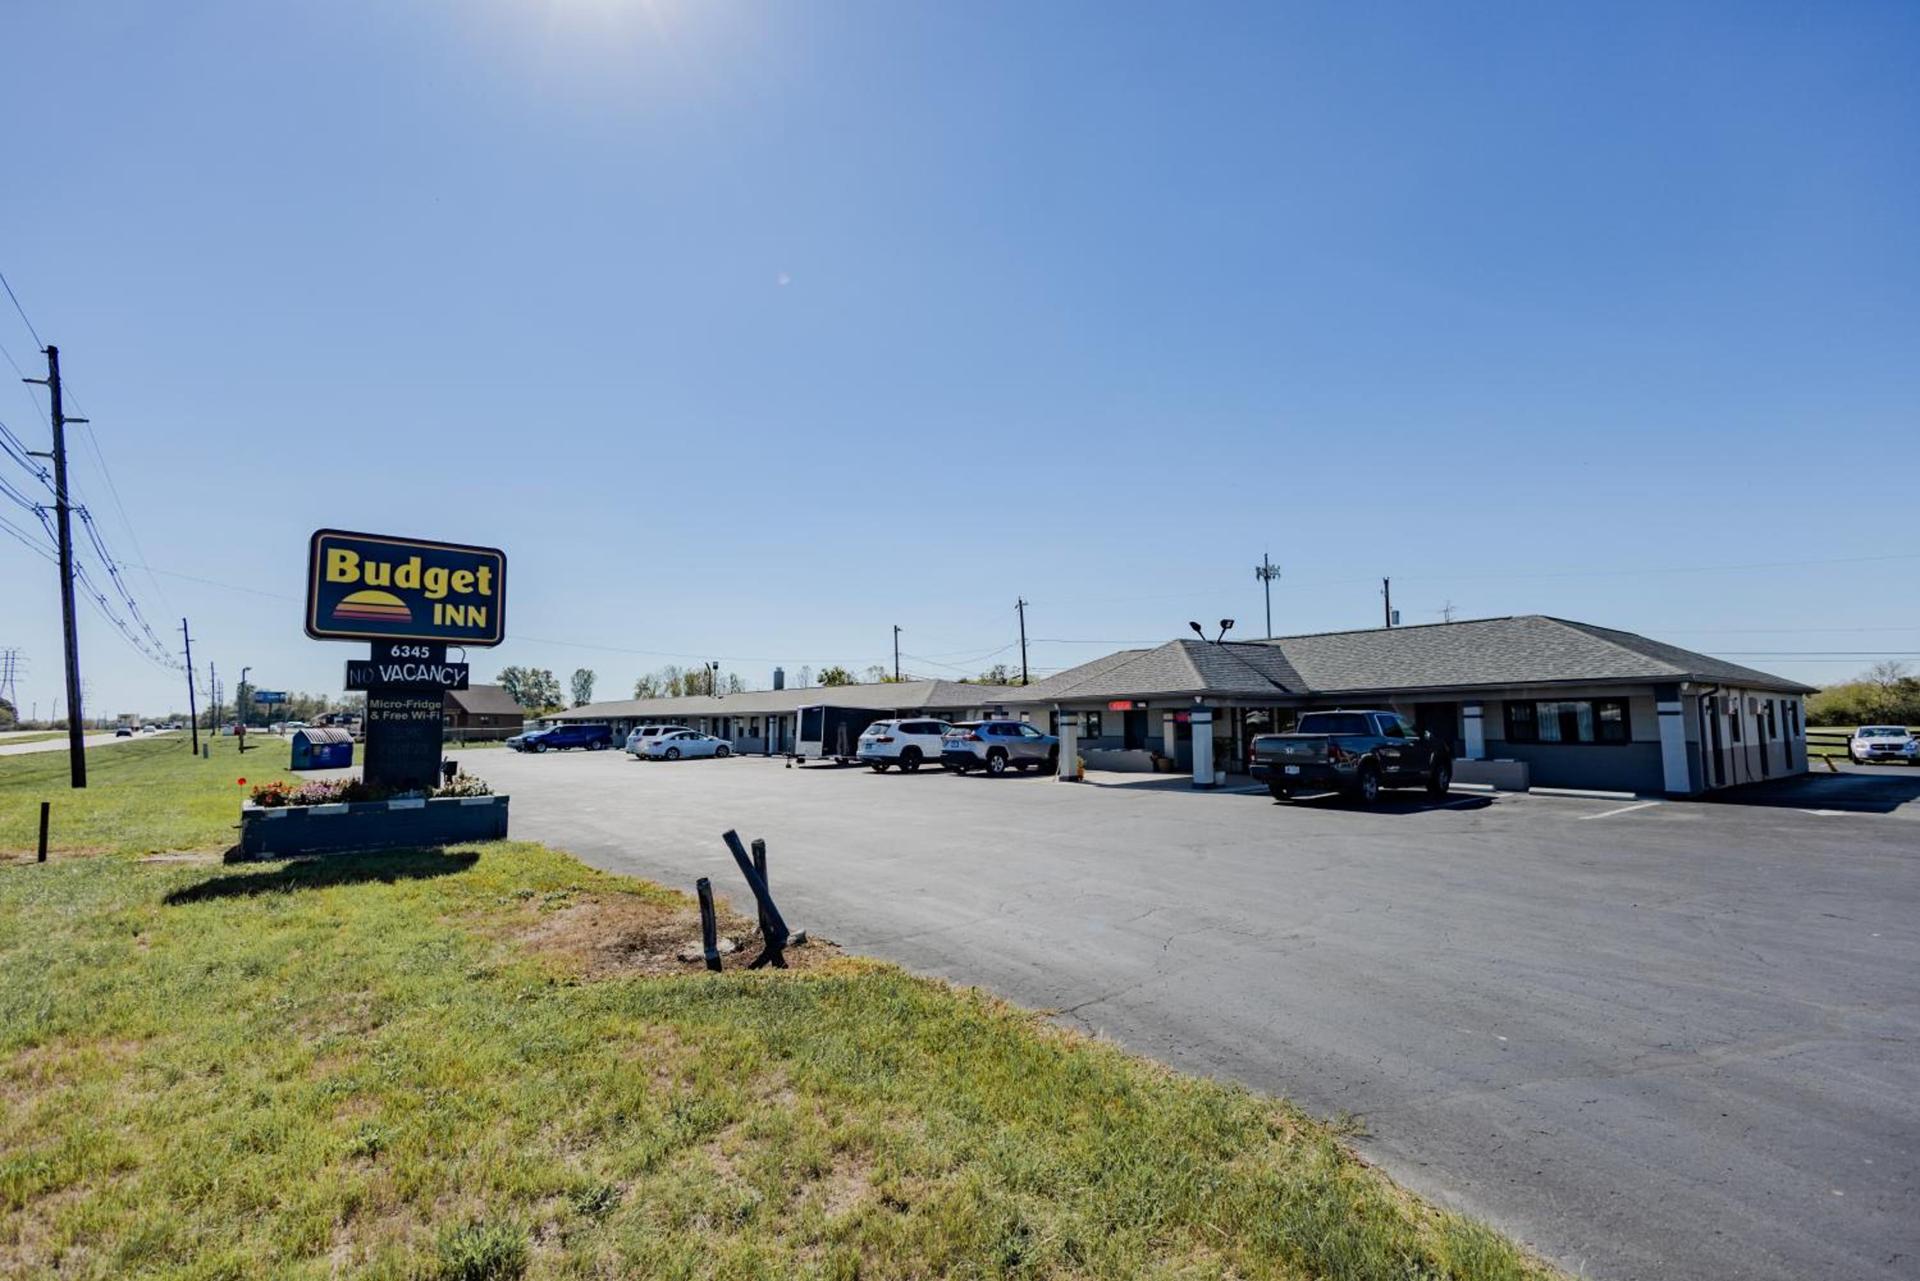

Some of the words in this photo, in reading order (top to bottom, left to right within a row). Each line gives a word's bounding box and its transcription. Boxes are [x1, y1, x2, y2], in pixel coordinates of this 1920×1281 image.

[326, 548, 492, 599] Budget
[433, 603, 487, 628] INN
[390, 645, 430, 659] 6345
[349, 668, 374, 684] NO
[379, 664, 466, 686] VACANCY
[369, 699, 441, 709] Micro-Fridge
[370, 711, 379, 720] &
[383, 711, 409, 720] Free
[412, 711, 440, 720] Wi-Fi
